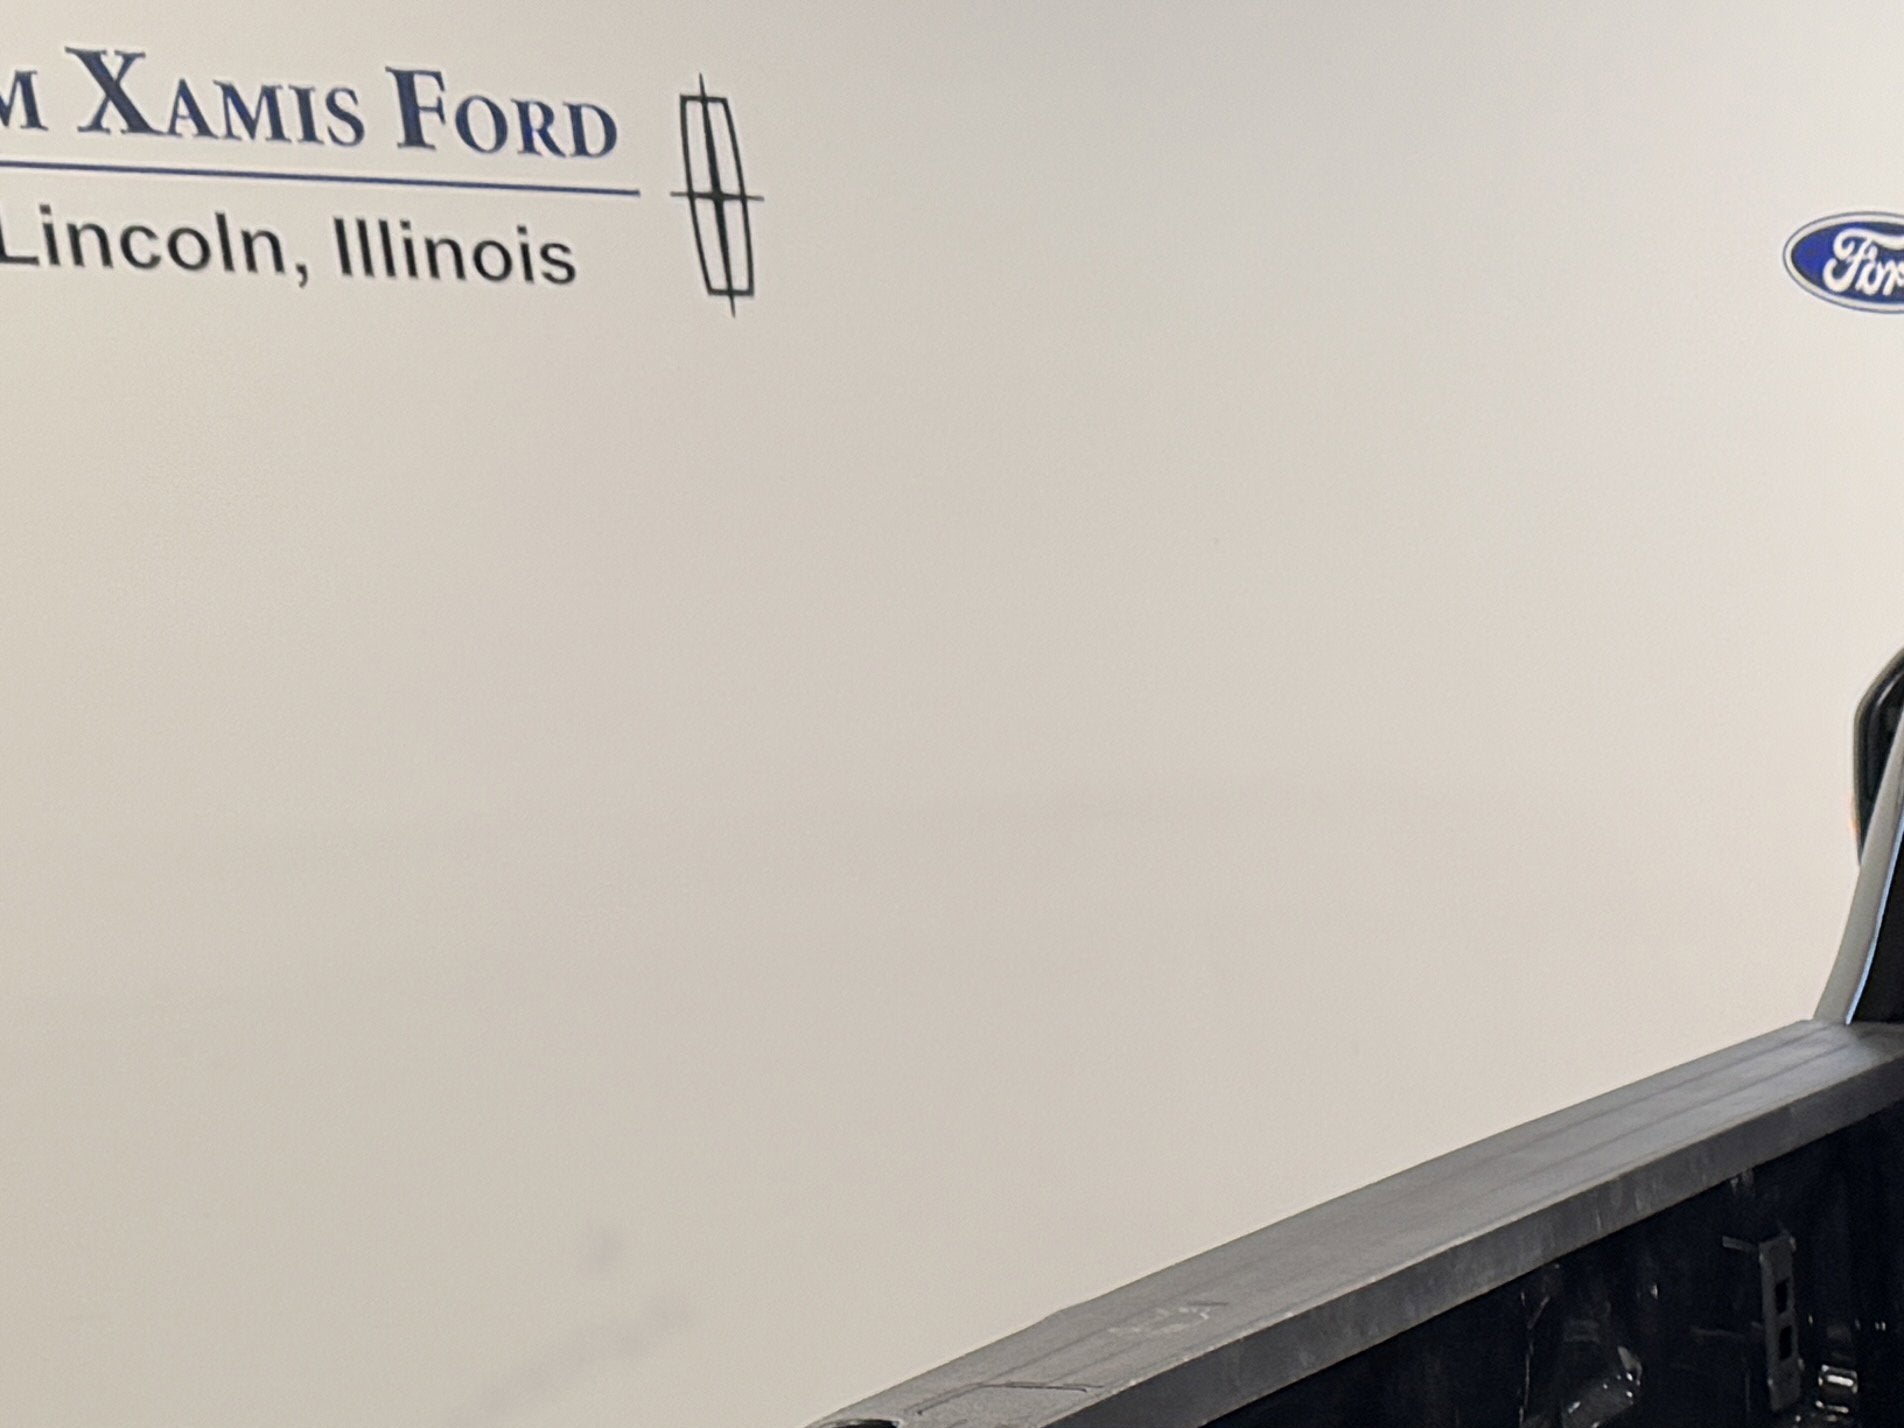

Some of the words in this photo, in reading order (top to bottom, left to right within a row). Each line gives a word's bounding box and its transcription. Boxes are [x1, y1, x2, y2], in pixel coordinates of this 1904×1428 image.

[64, 46, 365, 147] XAMIS
[385, 65, 618, 158] FORD
[0, 203, 309, 288] Lincoln,
[333, 216, 577, 286] Illinois
